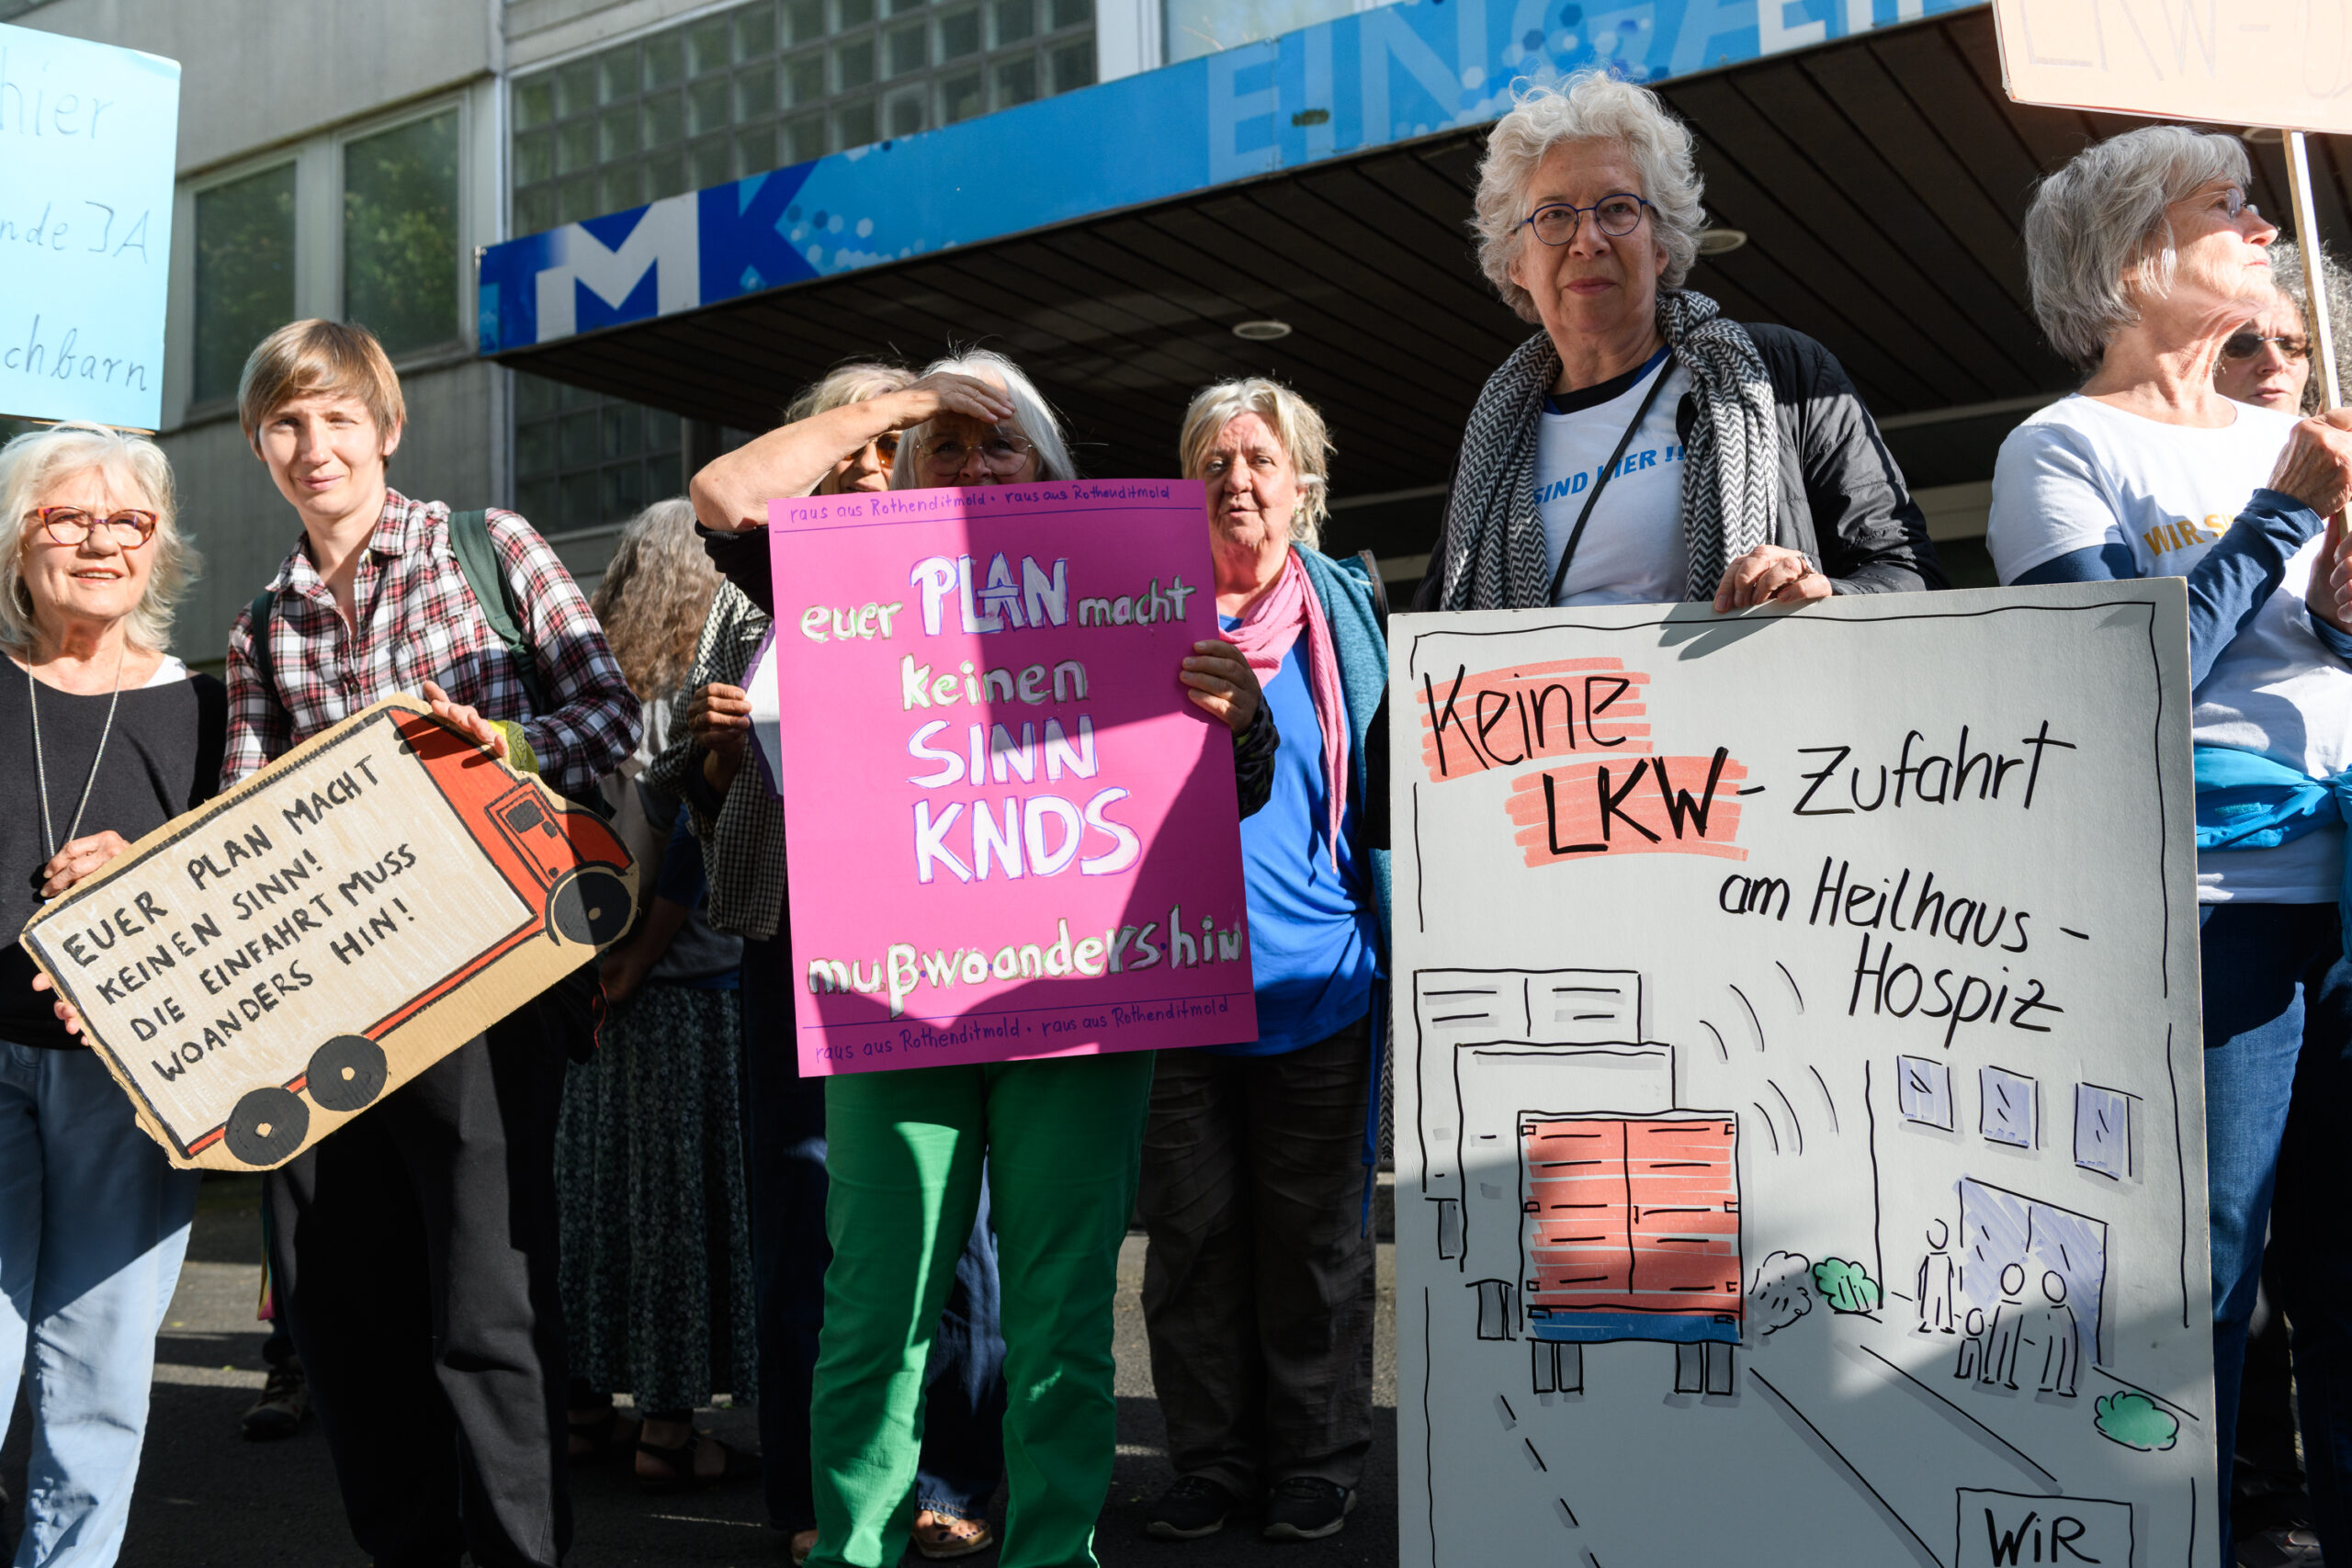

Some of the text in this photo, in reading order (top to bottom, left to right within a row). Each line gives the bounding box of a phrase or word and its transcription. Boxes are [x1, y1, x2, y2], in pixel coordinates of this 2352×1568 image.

[0, 46, 114, 139] hier
[480, 158, 825, 353] TMK
[5, 314, 147, 391] chbarn
[790, 507, 828, 523] raus
[837, 506, 863, 517] aus
[871, 493, 985, 516] Rothenditmold
[1005, 490, 1039, 502] raus
[1044, 491, 1068, 501] aus
[1533, 472, 1588, 504] SIND
[2143, 520, 2205, 557] WIR
[799, 552, 1196, 643] euer PLAN macht
[900, 653, 1090, 711] keinen
[1424, 664, 1630, 777] Keine
[906, 715, 1099, 789] SINN
[1793, 720, 2077, 815] Zufahrt
[63, 755, 378, 966] EUER PLAN MACHT
[911, 786, 1142, 884] KNDS
[96, 849, 322, 1005] KEINEN SINN!
[130, 843, 416, 1041] DIE EINFAHRT MUSS
[1719, 874, 1791, 921] am
[152, 897, 415, 1081] WOANDERS HIN!
[815, 995, 1228, 1064] raus aus Rothenditmold raus aus Rothenditmold
[1849, 932, 2064, 1049] Hospiz
